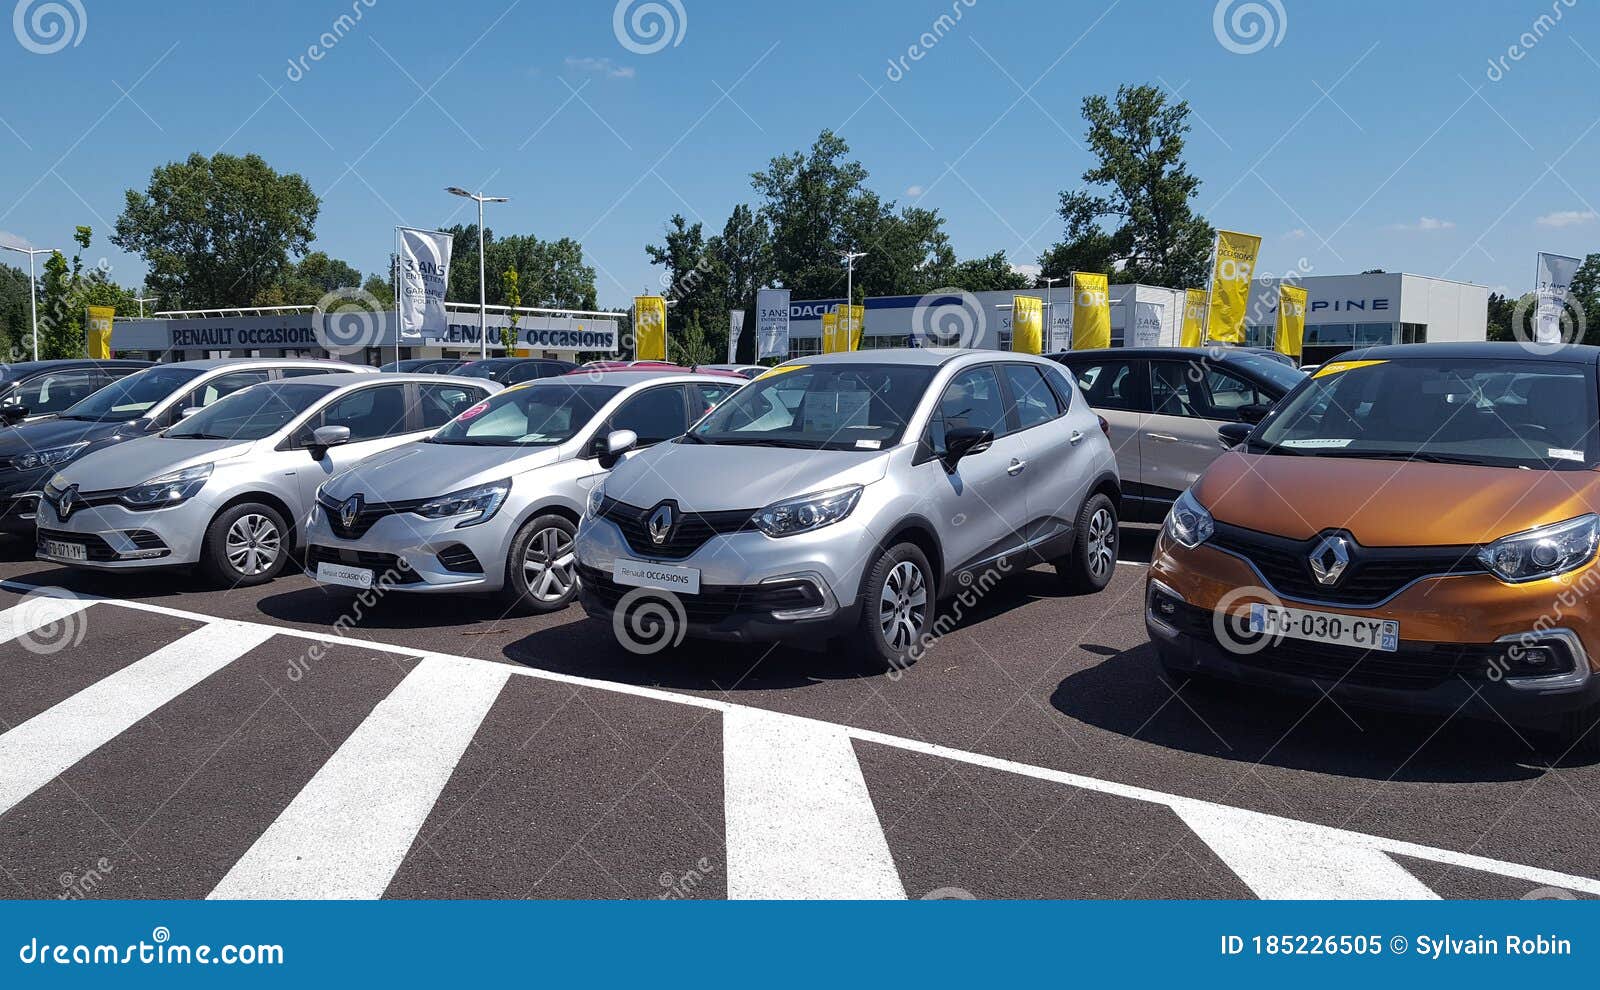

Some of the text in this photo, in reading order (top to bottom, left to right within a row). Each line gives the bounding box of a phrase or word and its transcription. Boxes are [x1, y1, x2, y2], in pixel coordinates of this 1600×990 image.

[405, 259, 446, 277] 3 ANS
[1221, 259, 1251, 283] OR
[1079, 291, 1106, 307] OR
[1269, 298, 1389, 314] PINE
[762, 309, 788, 317] 3 ANS
[790, 304, 838, 317] DACIA
[1018, 311, 1040, 323] OR
[1282, 302, 1303, 317] OR
[89, 319, 109, 331] OR
[1144, 318, 1160, 326] ANS
[172, 326, 317, 346] RENAULT occasions
[434, 324, 614, 347] ENAUT occasions
[825, 325, 837, 335] O
[621, 567, 689, 584] Renault OCCASIONS
[1266, 608, 1381, 645] FG-030-CY
[1383, 636, 1395, 648] 2A
